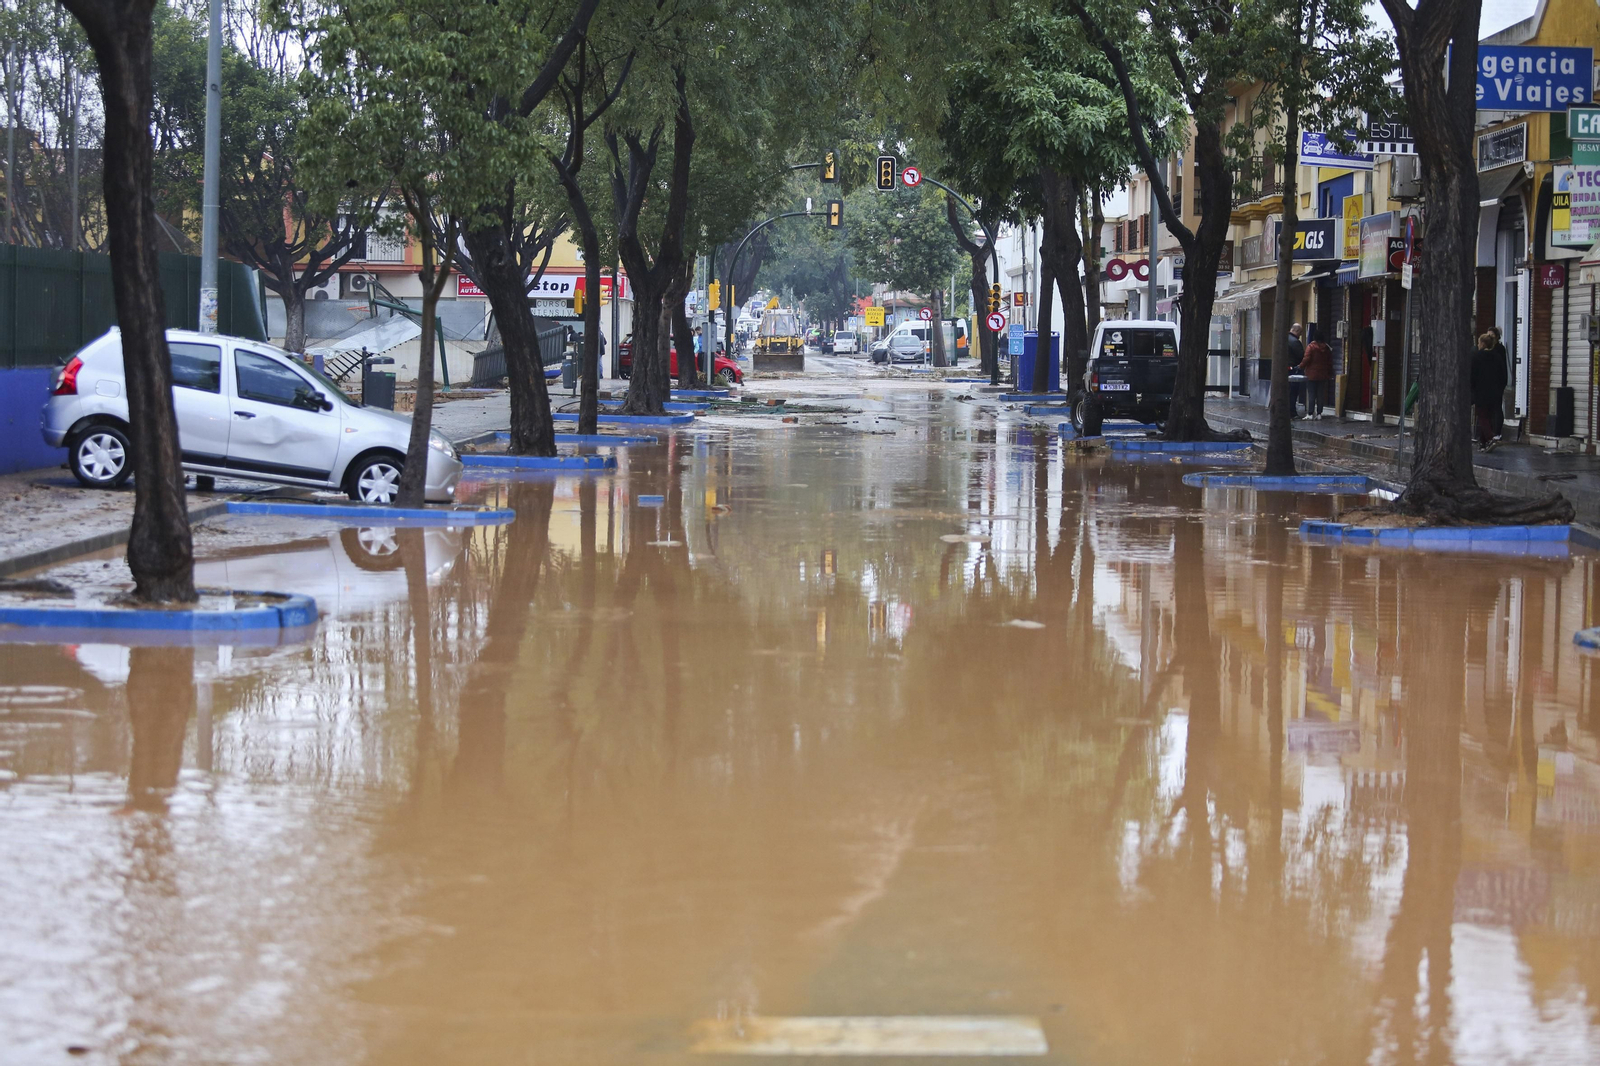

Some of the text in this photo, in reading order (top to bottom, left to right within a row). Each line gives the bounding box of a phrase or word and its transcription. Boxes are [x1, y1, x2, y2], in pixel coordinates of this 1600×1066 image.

[1477, 51, 1575, 78] gencia
[1475, 74, 1585, 108] e Viajes
[1305, 230, 1325, 250] GLS
[533, 281, 570, 293] stop
[536, 300, 567, 308] CURSO
